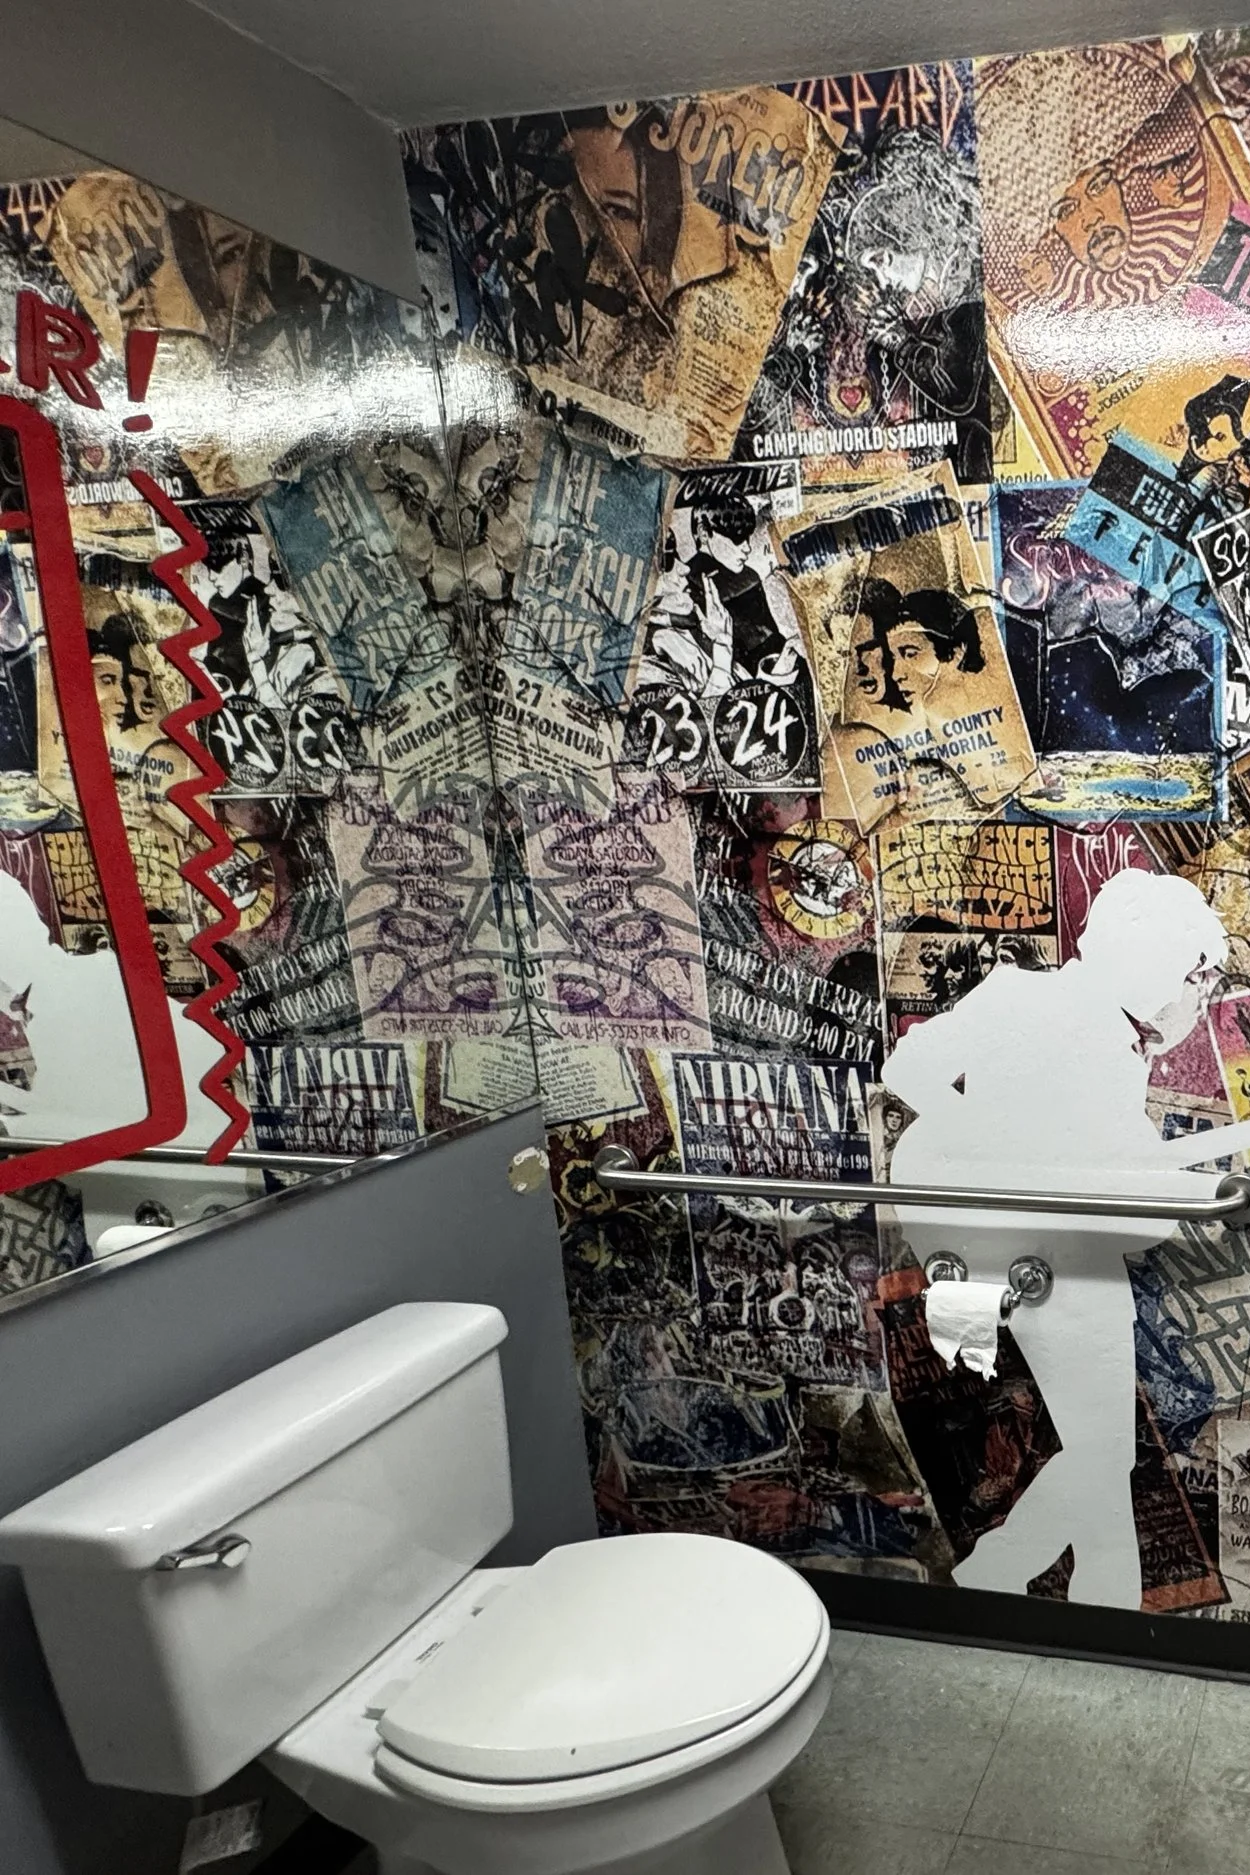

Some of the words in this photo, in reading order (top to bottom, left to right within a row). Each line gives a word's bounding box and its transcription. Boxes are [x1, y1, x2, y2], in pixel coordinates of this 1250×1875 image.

[0, 289, 159, 432] R!
[753, 430, 824, 458] CAMPING
[827, 425, 883, 455] WORLD
[886, 421, 958, 450] STADIUM
[743, 463, 789, 493] LIVE
[515, 677, 544, 708] 27
[727, 684, 771, 702] SEATTLE
[485, 694, 605, 761] UDITORIUM
[641, 693, 702, 769] 23
[726, 691, 799, 767] 24
[942, 706, 1004, 739] COUNTY
[751, 752, 783, 769] MOORE
[873, 752, 909, 778] WAR
[914, 731, 998, 762] MEMORIAL
[956, 762, 967, 776] 6
[704, 938, 805, 1006] COMPTON
[806, 975, 886, 1031] TERRAC
[714, 985, 799, 1039] AROUND
[800, 1016, 839, 1055] 9:00
[840, 1028, 876, 1063] PM
[675, 1058, 871, 1134] NIRVANA
